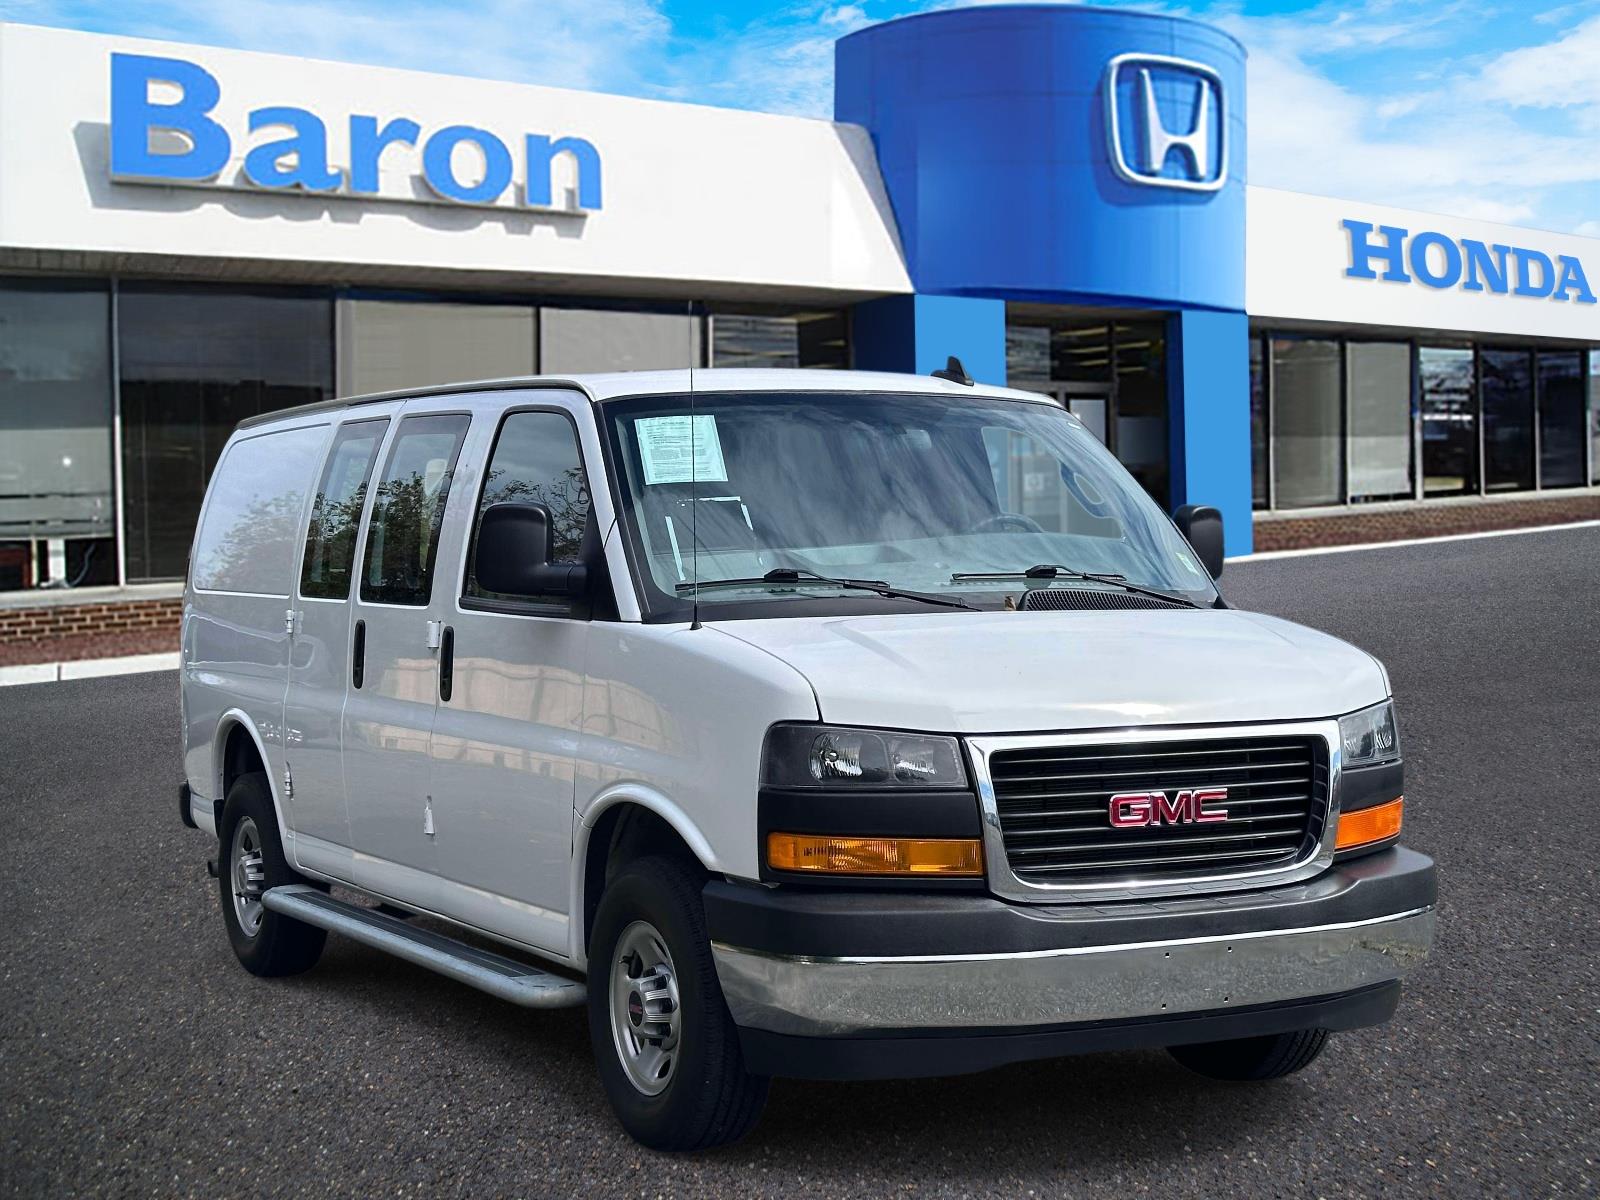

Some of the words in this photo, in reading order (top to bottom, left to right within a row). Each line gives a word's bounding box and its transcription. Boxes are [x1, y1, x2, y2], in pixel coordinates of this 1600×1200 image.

[110, 52, 603, 211] Baron
[1342, 218, 1597, 304] HONDA
[1109, 787, 1228, 827] GMC
